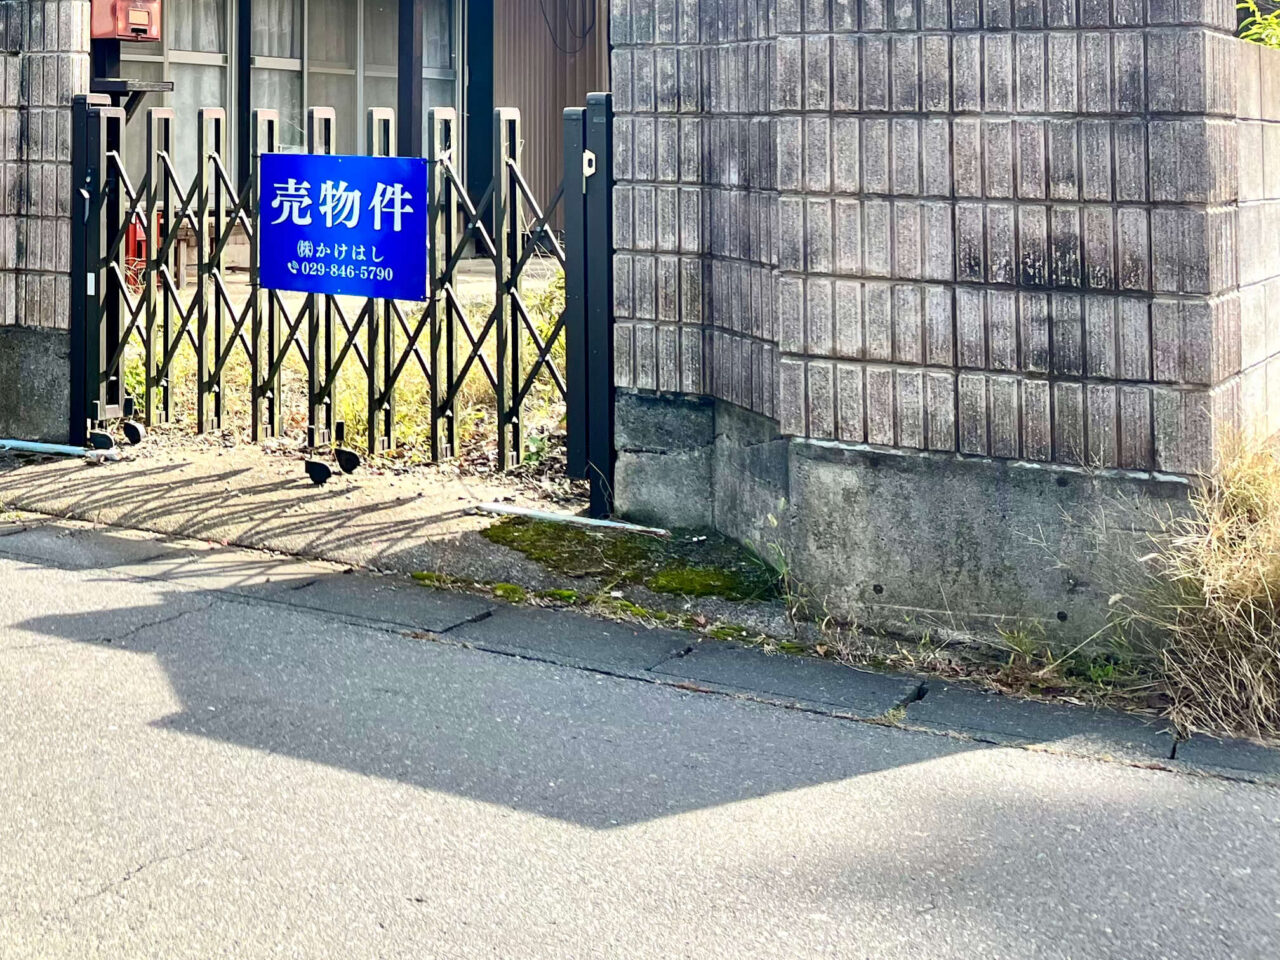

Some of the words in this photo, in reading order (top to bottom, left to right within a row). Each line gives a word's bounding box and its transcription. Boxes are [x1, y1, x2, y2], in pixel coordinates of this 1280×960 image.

[271, 178, 414, 232] 売物件
[301, 261, 394, 281] 029-846-5790
